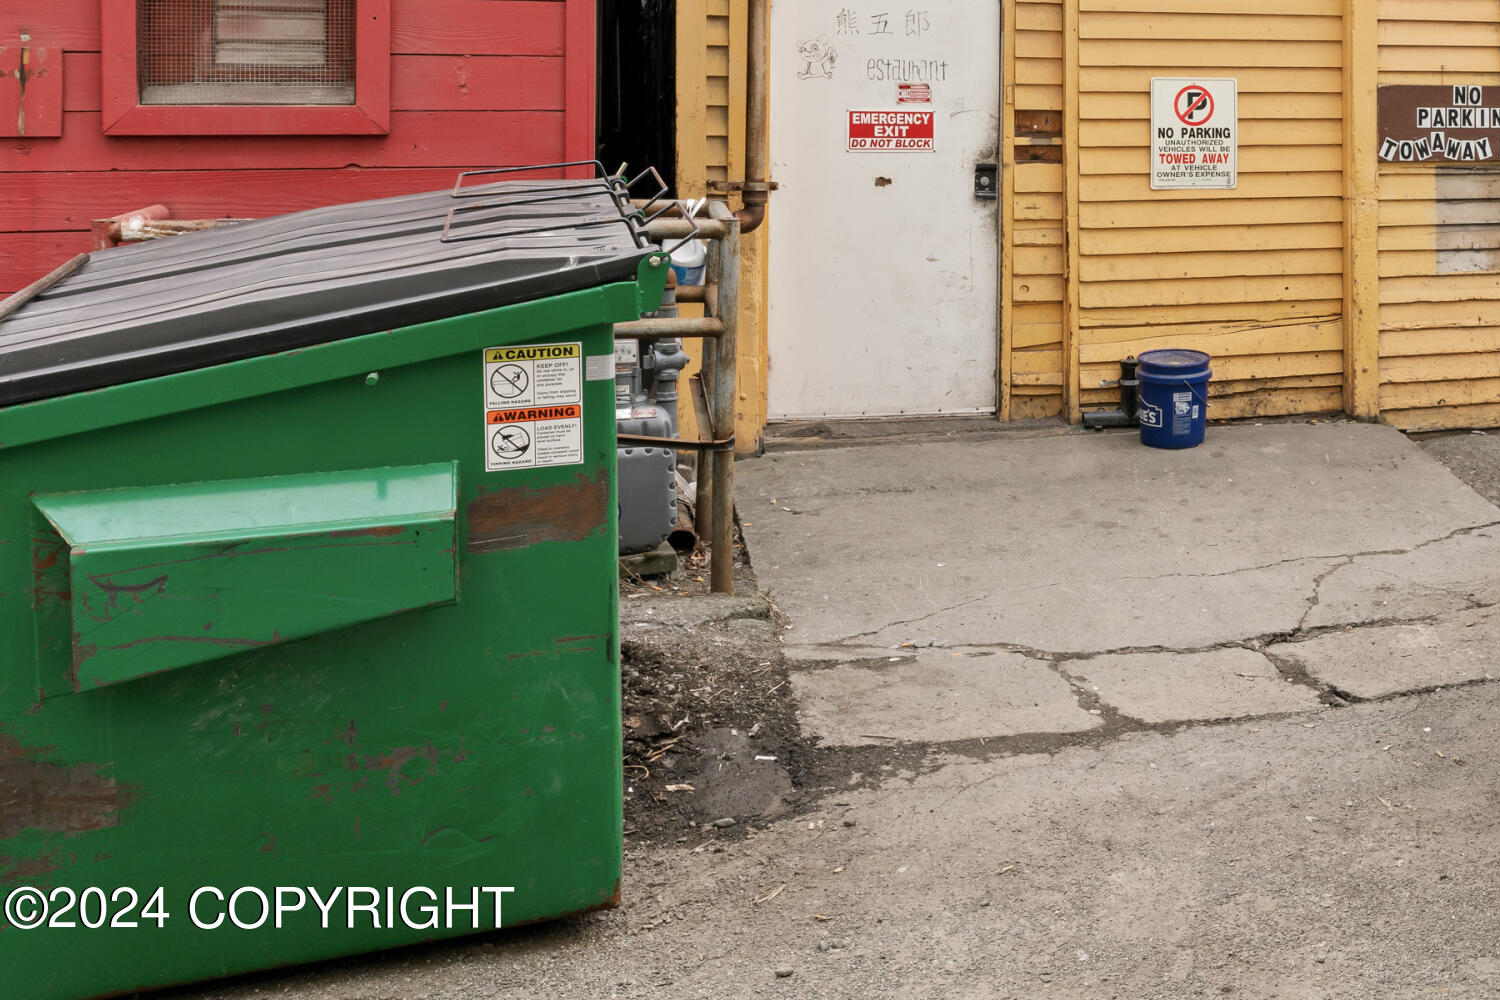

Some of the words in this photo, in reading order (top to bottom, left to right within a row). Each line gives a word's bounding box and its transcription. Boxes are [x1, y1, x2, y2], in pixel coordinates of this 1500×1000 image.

[1454, 86, 1482, 105] NO
[852, 112, 930, 125] EMERGENCY
[874, 125, 909, 137] EXIT
[1158, 127, 1174, 139] NO
[1181, 127, 1231, 139] PARKING
[851, 139, 866, 148] DO
[869, 139, 892, 148] NOT
[895, 139, 931, 148] BLOCK
[1159, 153, 1196, 164] TOWED
[1201, 153, 1229, 164] AWAY
[505, 346, 573, 360] CAUTION
[503, 407, 576, 421] WARNING
